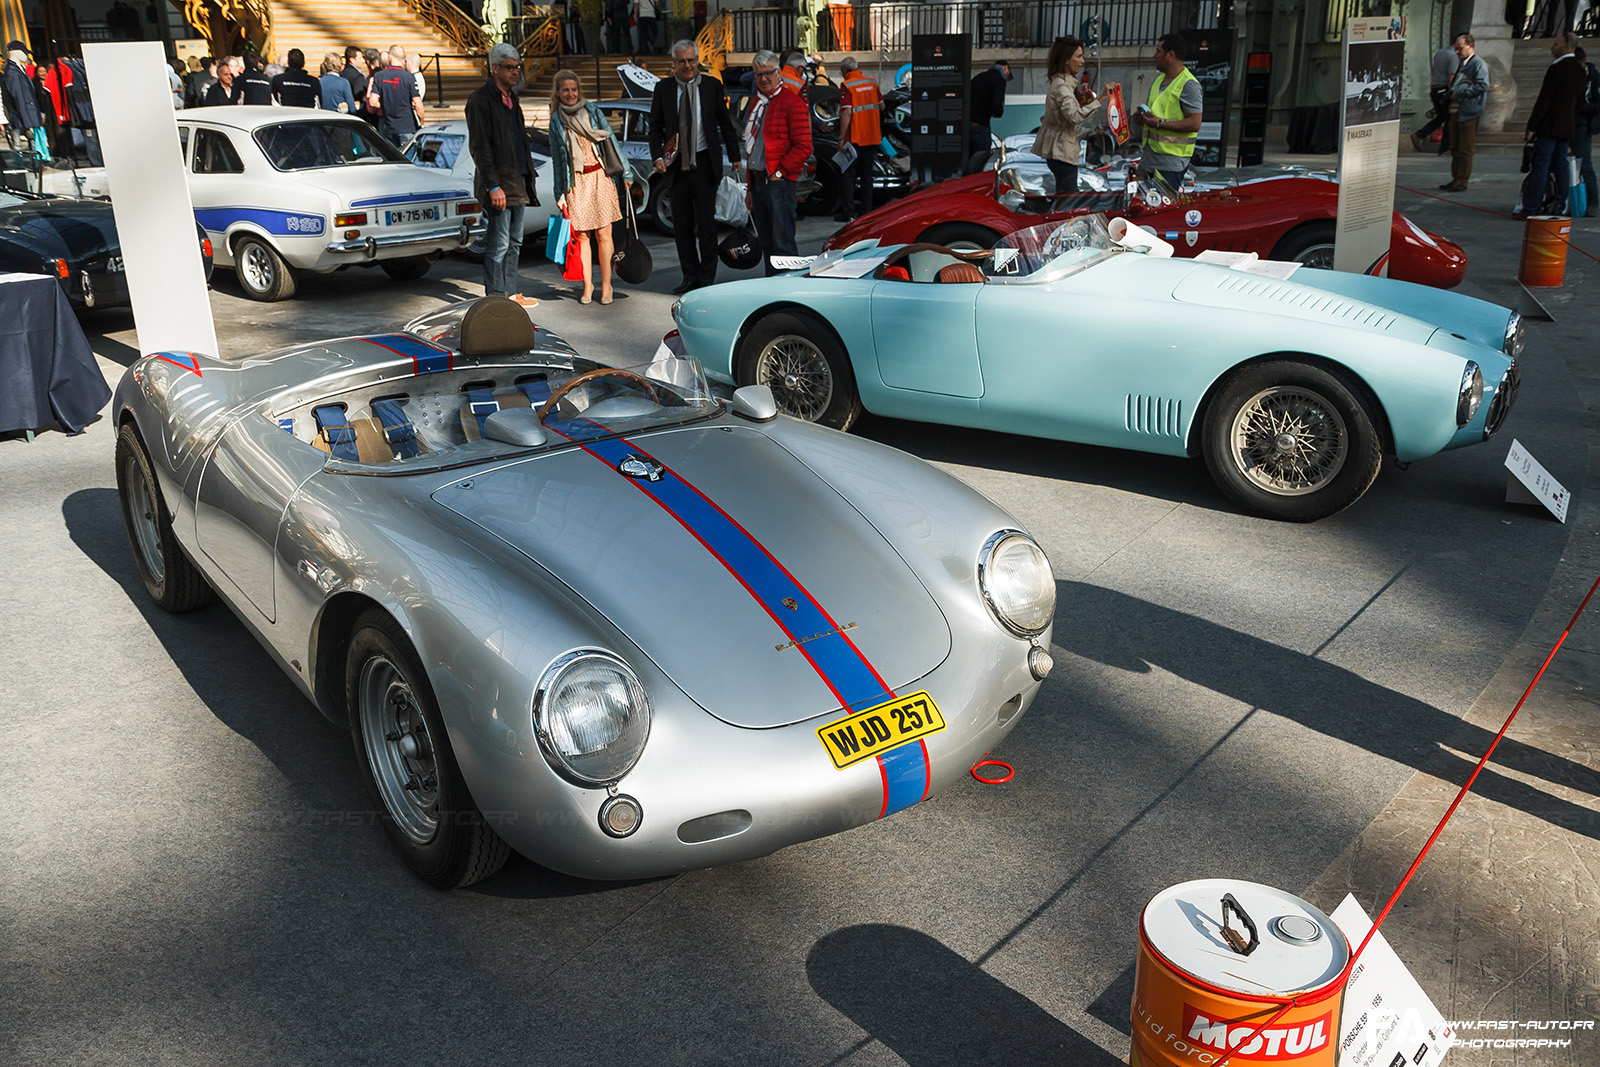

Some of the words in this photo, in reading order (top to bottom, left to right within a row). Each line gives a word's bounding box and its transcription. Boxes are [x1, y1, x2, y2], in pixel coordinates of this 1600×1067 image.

[775, 621, 859, 652] PORSCHE
[827, 715, 891, 757] WJD
[890, 699, 934, 735] 257
[1188, 1014, 1326, 1056] MOTUL
[1342, 1022, 1363, 1051] PORSCHE
